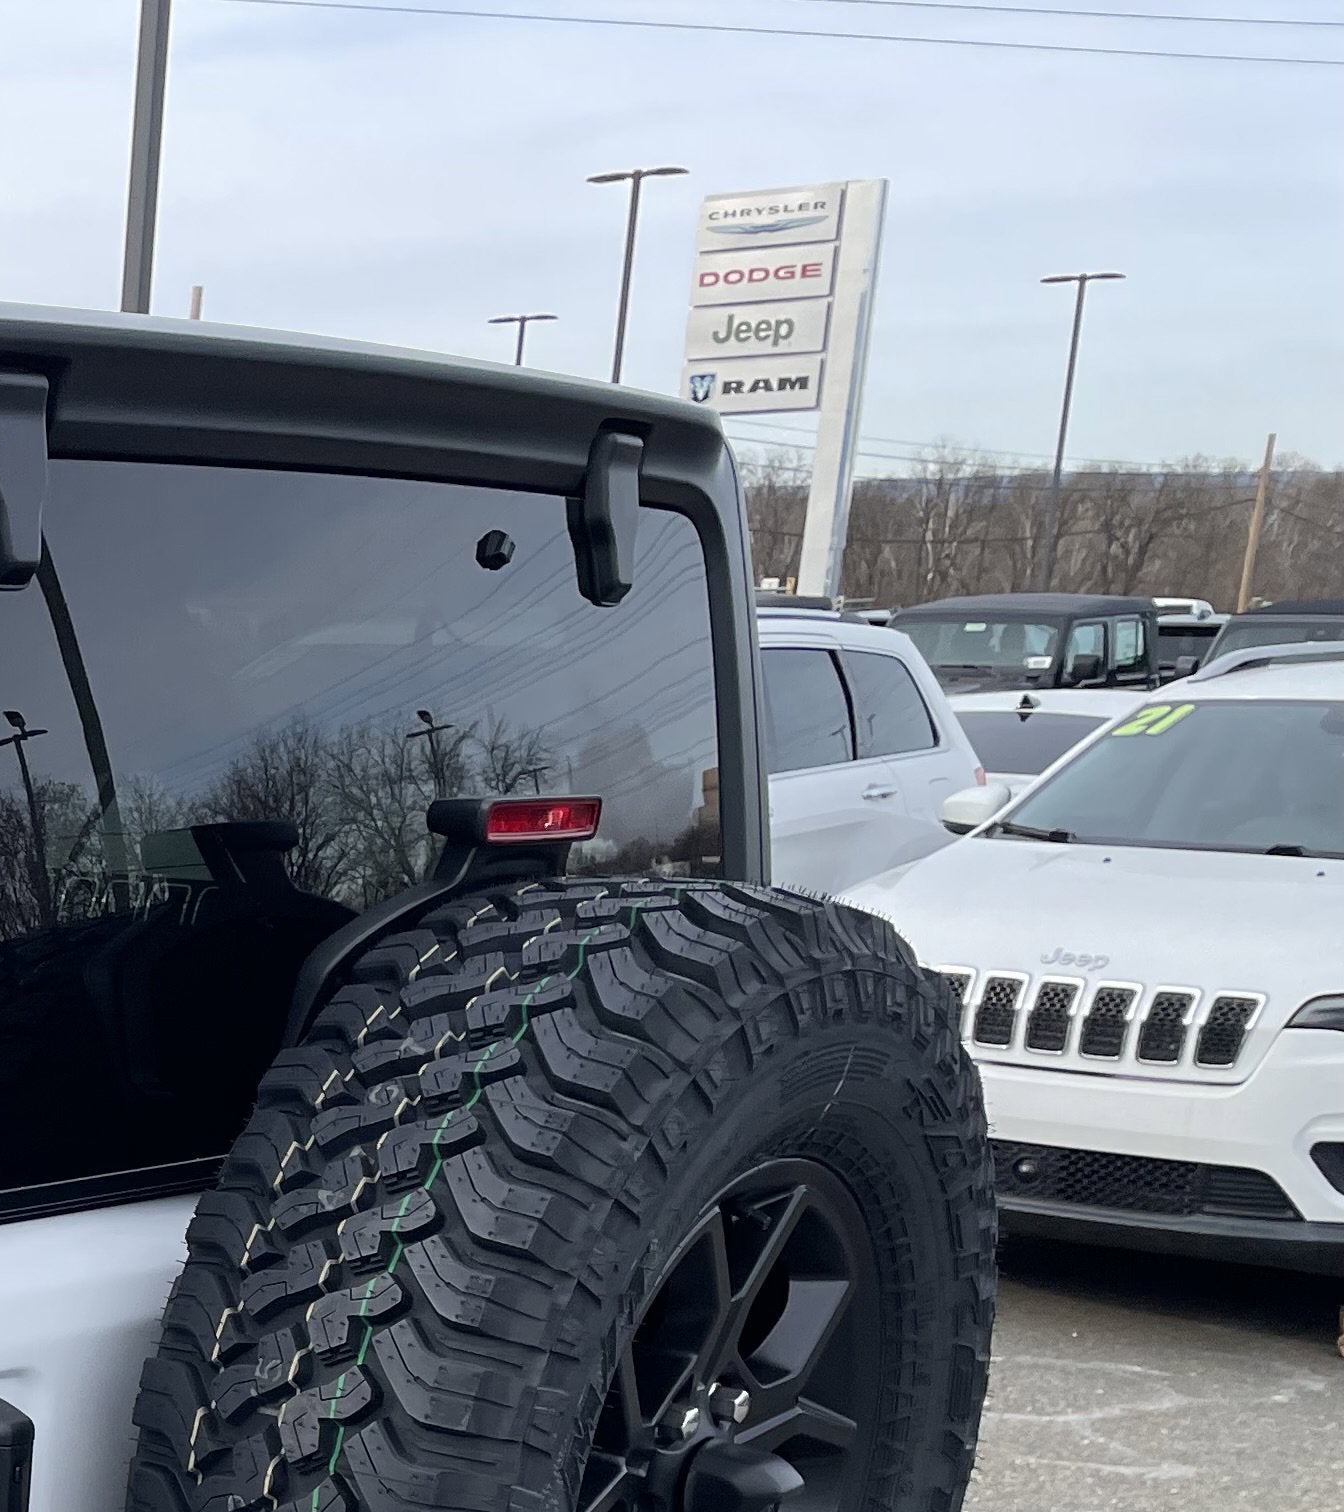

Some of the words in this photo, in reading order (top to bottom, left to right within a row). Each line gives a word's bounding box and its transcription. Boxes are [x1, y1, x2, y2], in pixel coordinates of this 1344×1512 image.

[708, 201, 827, 221] CHRYSLER
[699, 262, 823, 288] DODGE
[712, 313, 795, 347] Jeep
[721, 375, 810, 395] RAM
[1111, 703, 1196, 737] 21
[1040, 947, 1110, 971] Jeep
